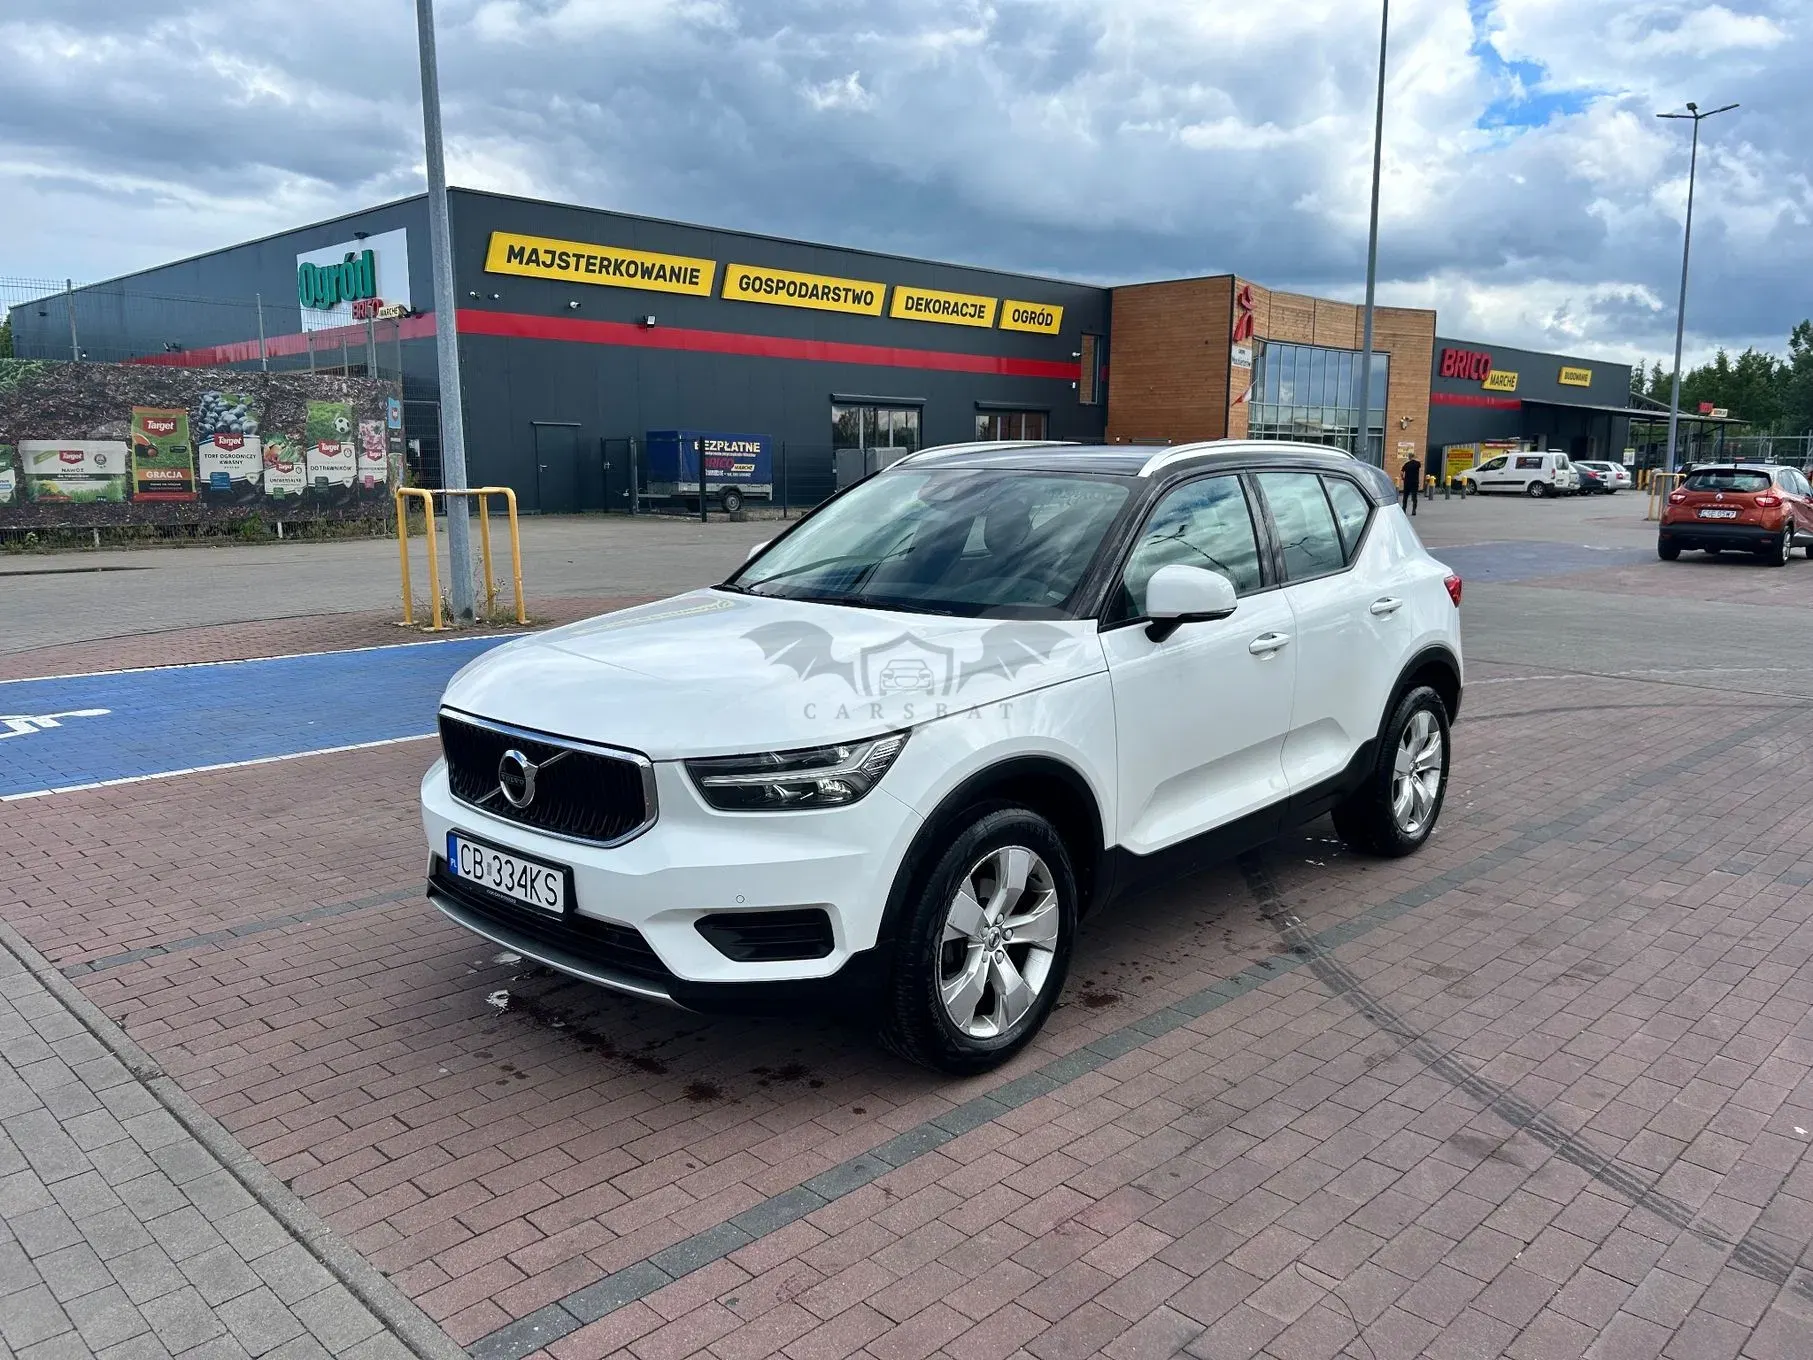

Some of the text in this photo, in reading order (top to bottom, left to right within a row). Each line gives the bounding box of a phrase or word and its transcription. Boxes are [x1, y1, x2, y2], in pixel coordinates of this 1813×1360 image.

[505, 244, 701, 285] MAJSTERKOWANIE
[299, 250, 376, 310] Ogród
[738, 274, 875, 307] GOSPODARSTWO
[904, 295, 986, 319] DEKORACJE
[1012, 308, 1053, 327] OGRÓD
[1440, 349, 1516, 388] BRICO MARCHE
[147, 420, 175, 431] Target
[218, 436, 242, 446] Target
[321, 443, 340, 453] Target
[146, 471, 183, 479] GRACJA
[450, 843, 558, 907] PL CB 334KS
